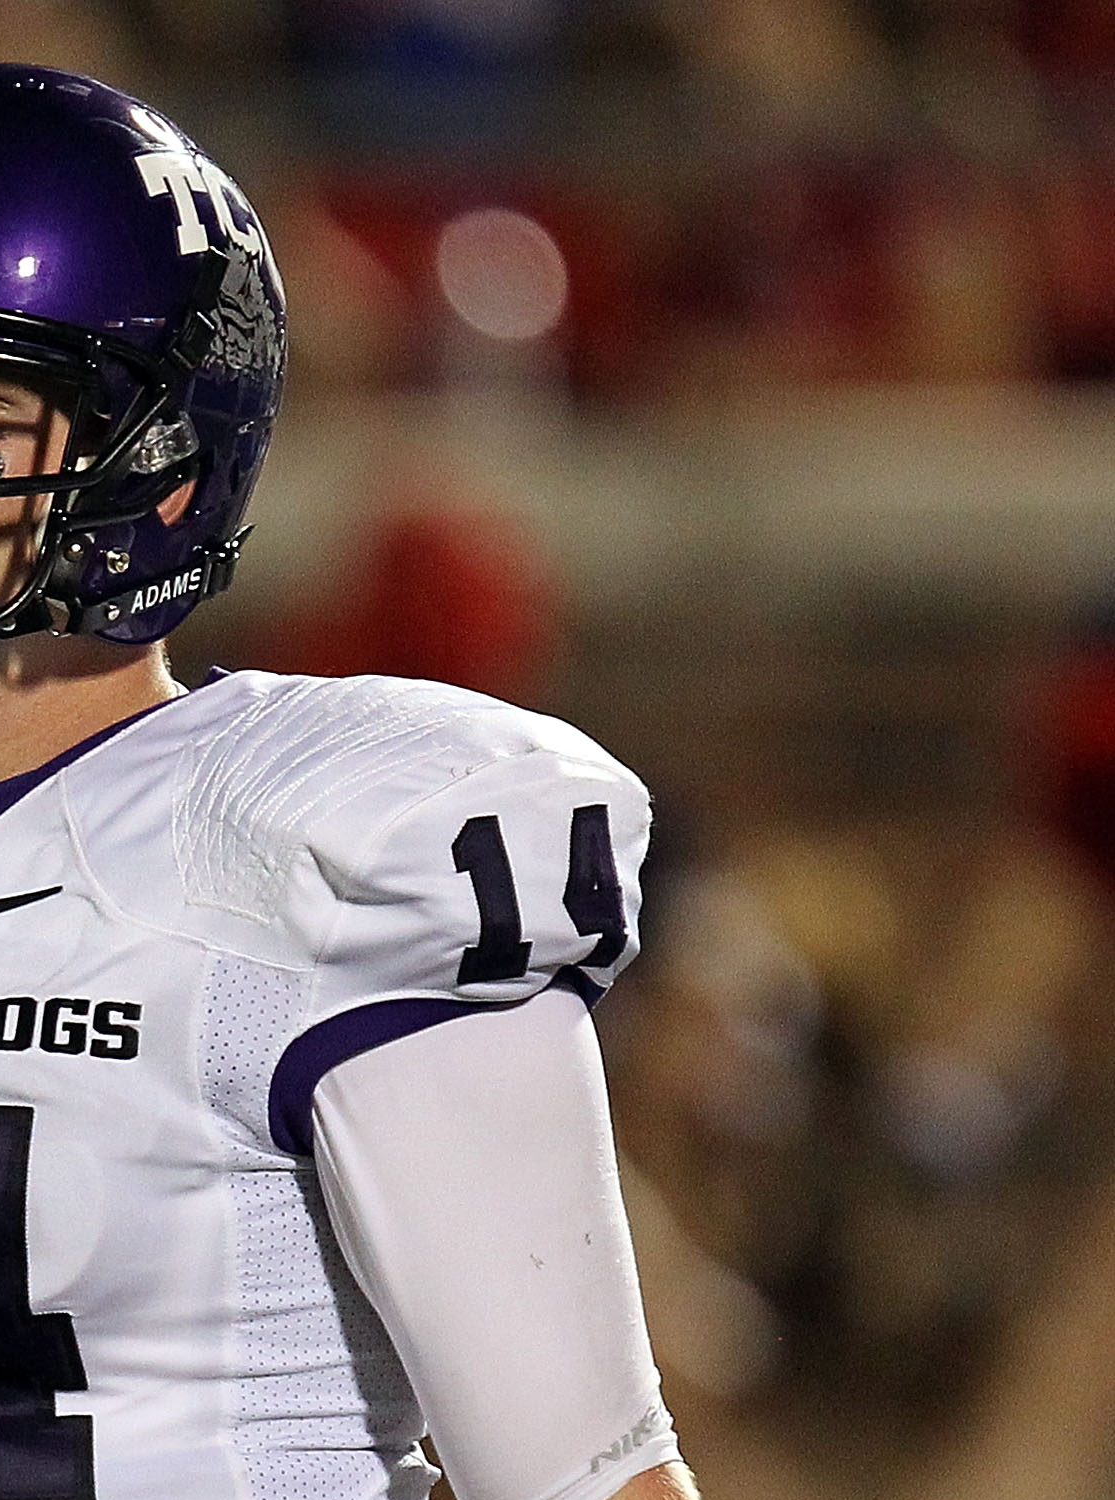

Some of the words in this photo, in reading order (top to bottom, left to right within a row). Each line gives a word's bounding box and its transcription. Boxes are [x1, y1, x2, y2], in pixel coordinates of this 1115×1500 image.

[135, 151, 280, 285] TC
[130, 567, 202, 614] ADAMS
[451, 803, 629, 985] 14
